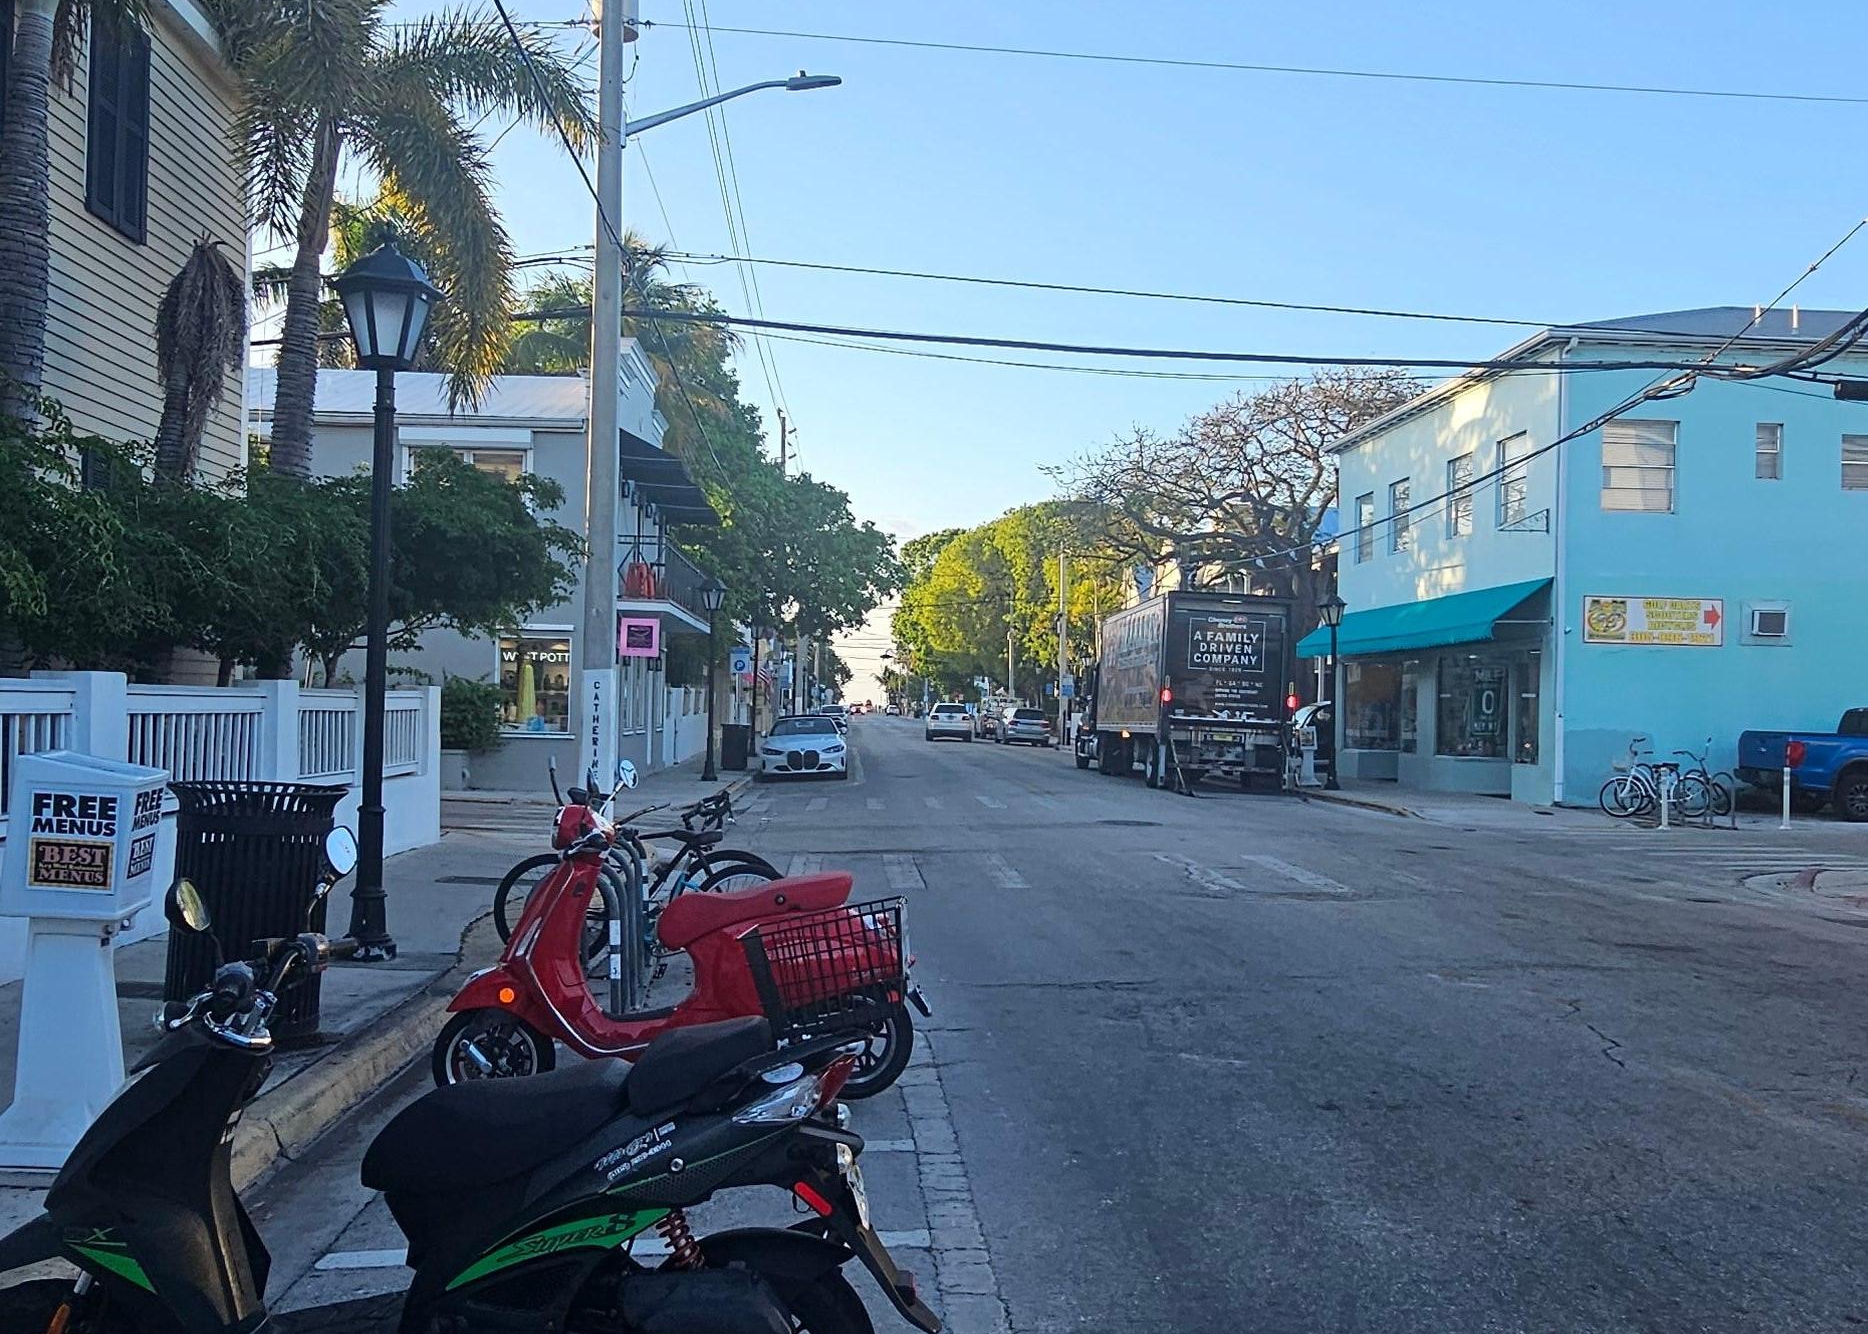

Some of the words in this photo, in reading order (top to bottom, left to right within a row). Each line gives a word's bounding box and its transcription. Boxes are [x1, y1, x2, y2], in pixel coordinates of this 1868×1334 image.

[1193, 630, 1203, 641] A
[1206, 630, 1259, 644] FAMILY
[503, 651, 538, 662] WT
[1199, 642, 1252, 654] DRIVEN
[1193, 653, 1258, 665] COMPANY
[33, 793, 117, 821] FREE
[133, 787, 165, 816] FREE
[31, 817, 117, 837] MENUS
[131, 810, 161, 832] MENUS
[38, 844, 107, 866] BEST
[38, 868, 105, 884] MENUS
